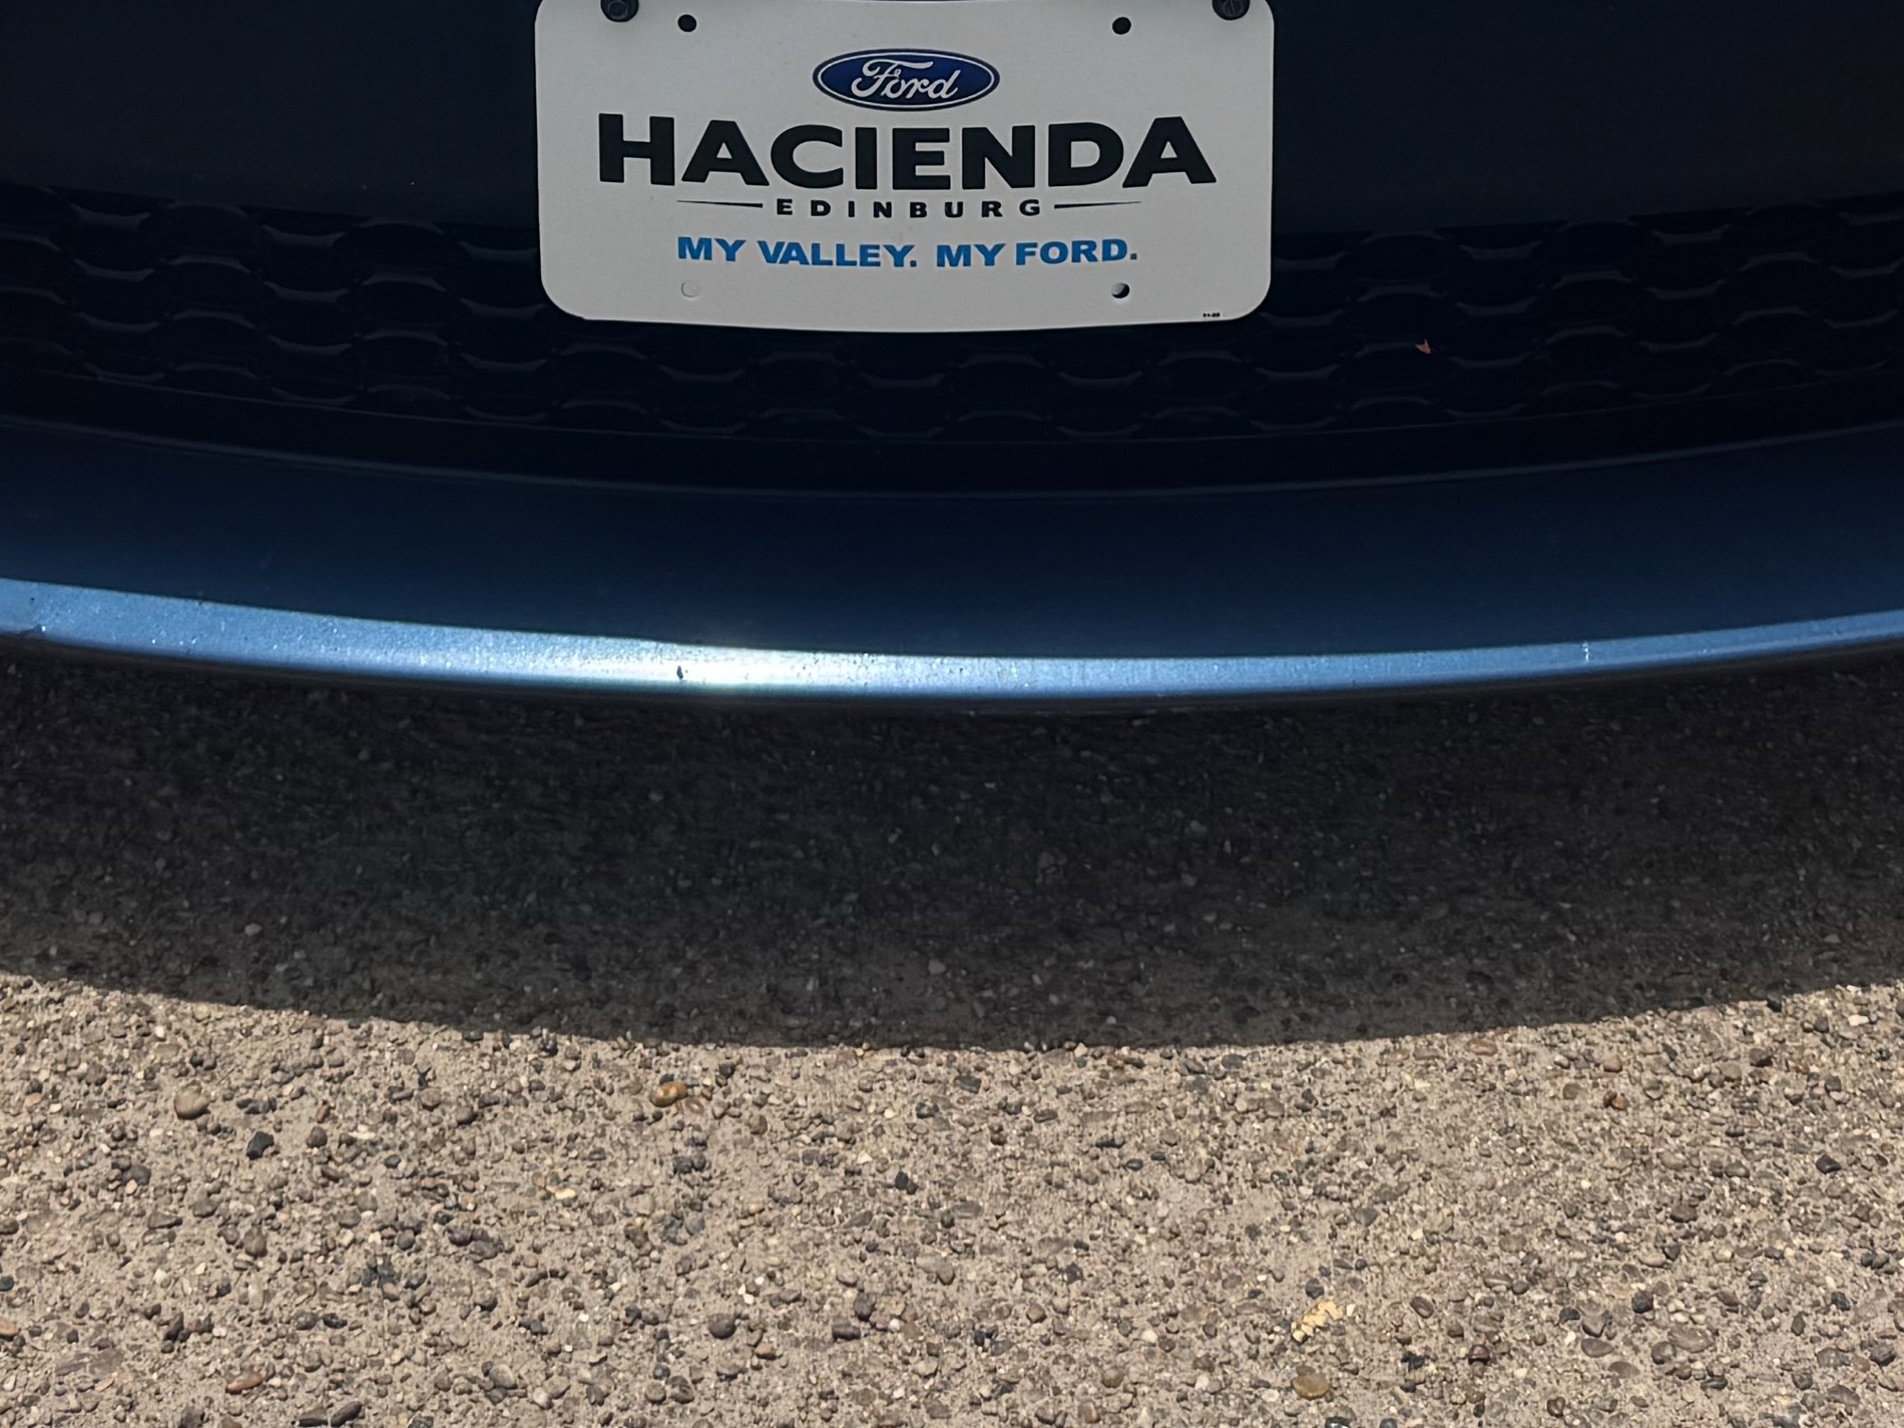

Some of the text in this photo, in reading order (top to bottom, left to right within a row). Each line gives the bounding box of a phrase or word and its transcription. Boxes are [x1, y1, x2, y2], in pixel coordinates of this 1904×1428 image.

[850, 55, 959, 100] Ford
[598, 113, 1217, 191] HACIENDA
[776, 198, 1041, 219] EDINBURG
[677, 236, 1138, 268] MY VALLEY. MY FORD.
